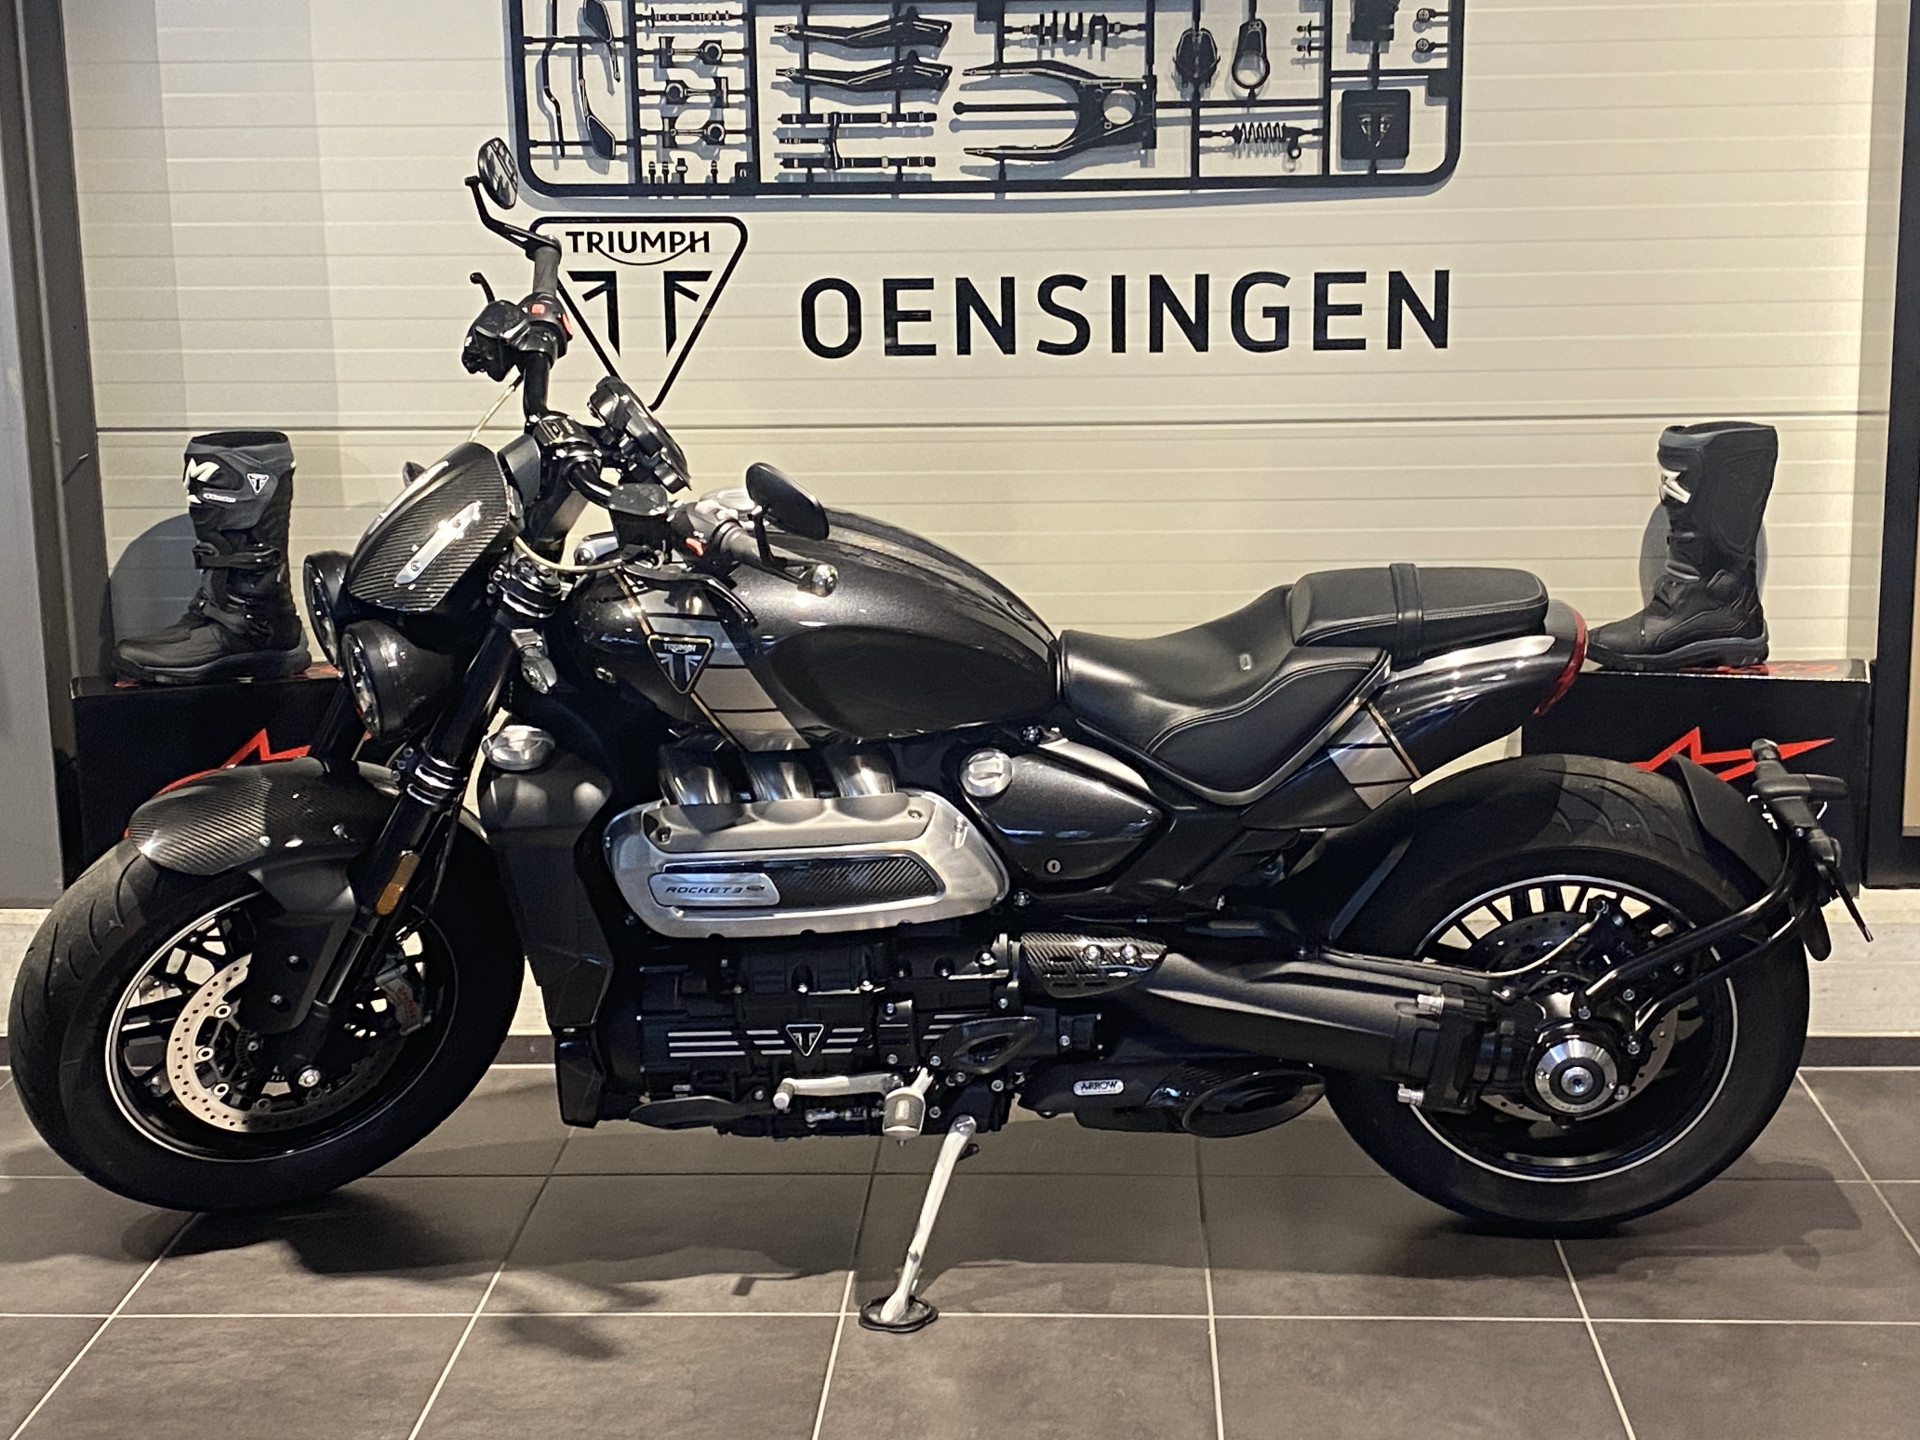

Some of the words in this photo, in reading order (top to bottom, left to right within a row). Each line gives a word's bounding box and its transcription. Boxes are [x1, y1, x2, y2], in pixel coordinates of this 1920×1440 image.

[565, 230, 711, 265] TRIUMPH
[800, 269, 1450, 360] OENSINGEN
[1080, 1080, 1118, 1091] ARROW
